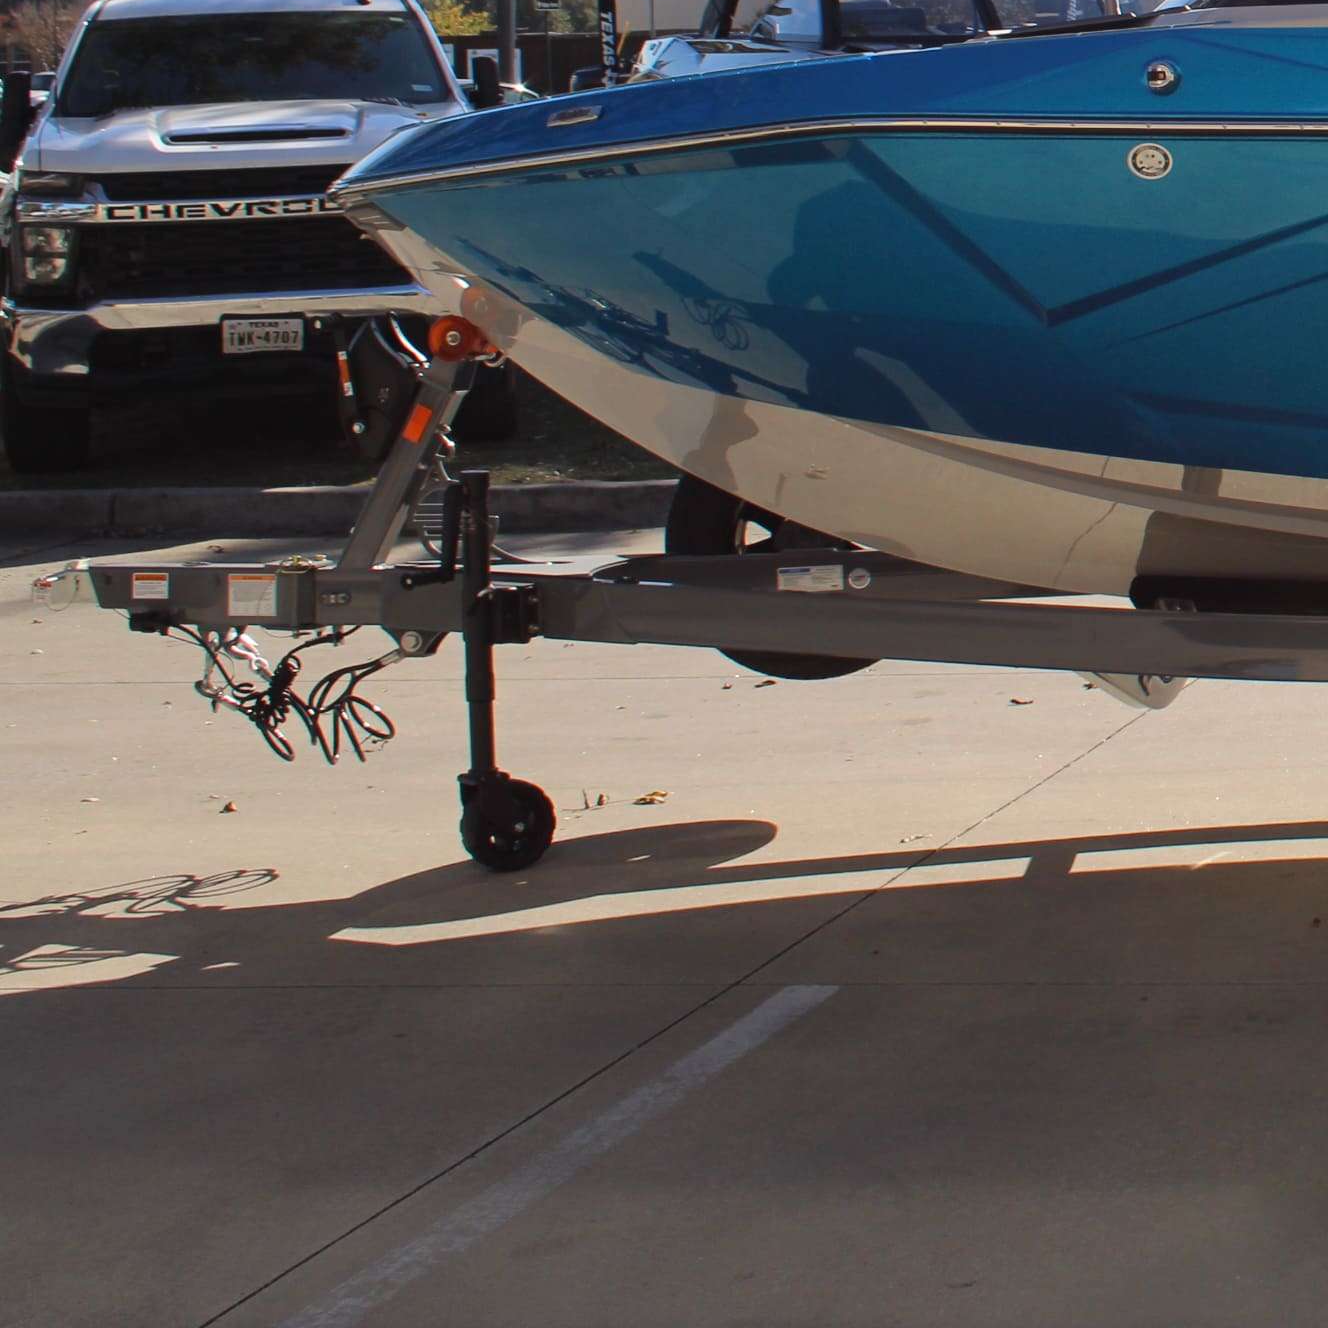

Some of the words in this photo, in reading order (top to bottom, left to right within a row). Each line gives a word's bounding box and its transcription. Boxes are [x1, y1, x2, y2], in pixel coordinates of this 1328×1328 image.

[600, 11, 616, 66] TEXAS
[106, 198, 343, 220] CHEVROL
[248, 321, 279, 329] TEXAS
